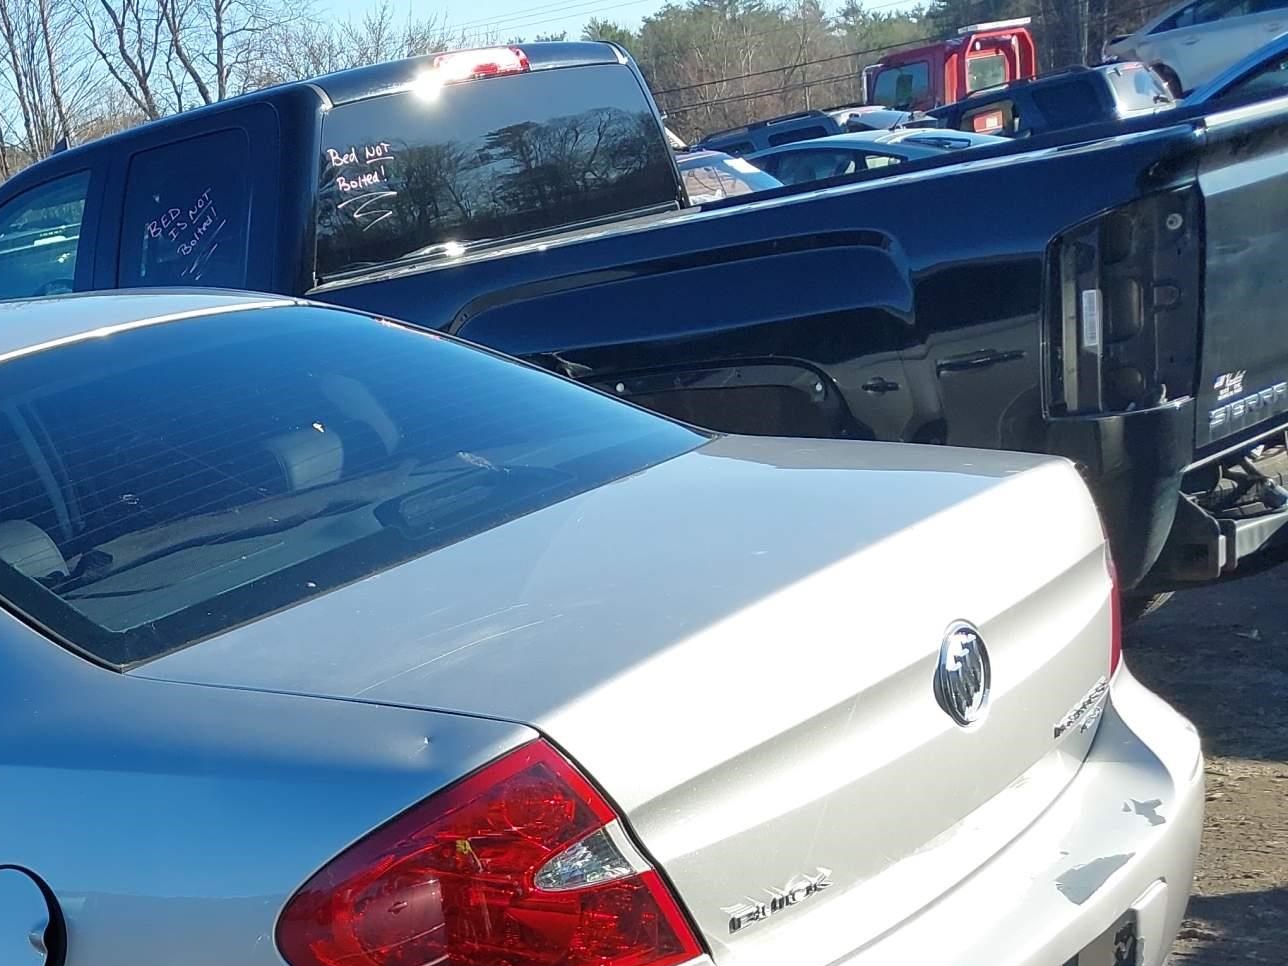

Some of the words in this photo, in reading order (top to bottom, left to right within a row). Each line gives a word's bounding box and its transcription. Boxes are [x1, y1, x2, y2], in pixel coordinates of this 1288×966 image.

[327, 147, 359, 167] Bed
[365, 142, 391, 160] NOT
[336, 164, 388, 192] Bolted!
[147, 207, 181, 238] BED
[168, 221, 188, 242] IS
[188, 186, 212, 221] NOT
